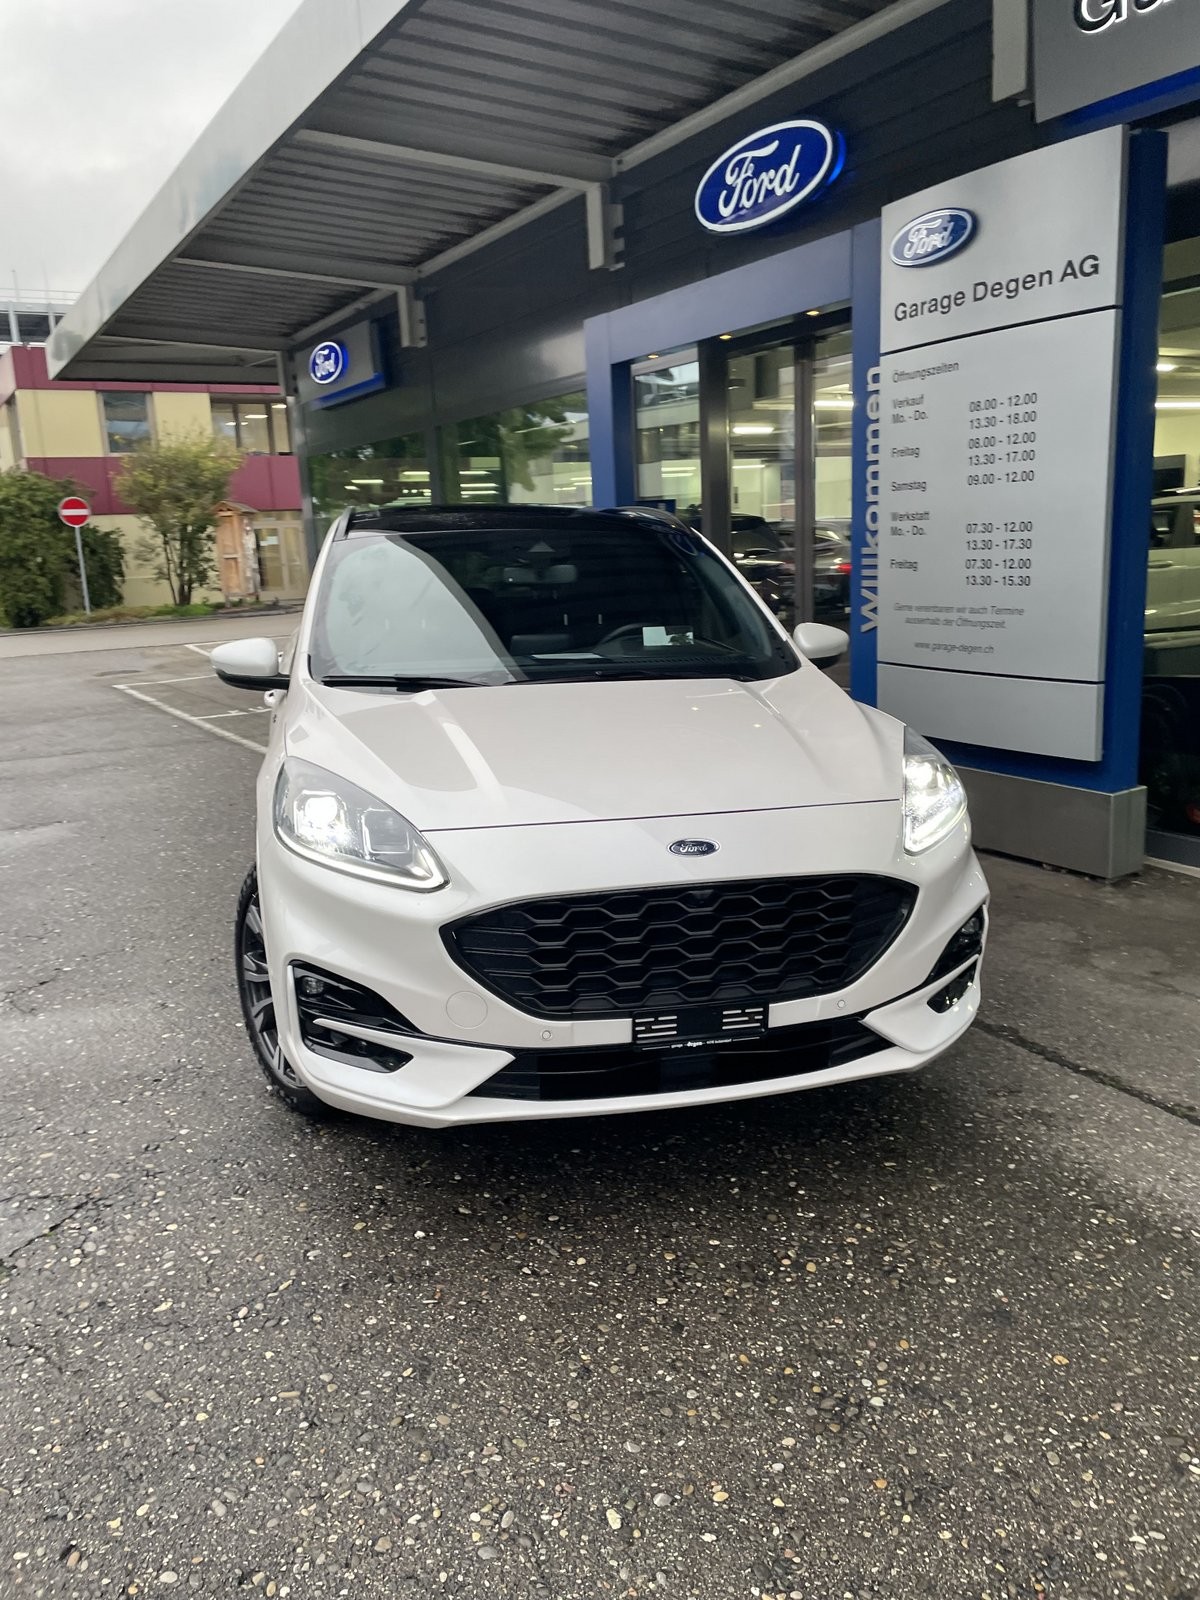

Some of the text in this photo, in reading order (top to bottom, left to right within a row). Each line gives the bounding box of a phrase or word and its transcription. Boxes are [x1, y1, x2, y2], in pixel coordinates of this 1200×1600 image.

[718, 140, 801, 217] Ford
[903, 218, 955, 259] Ford
[894, 254, 1100, 321] Garage Degen AG
[315, 348, 336, 378] Ford
[892, 362, 960, 384] Öffnungszeiten
[892, 394, 924, 409] Verkauf
[969, 398, 997, 412] 08.00
[1008, 392, 1038, 407] 12.00
[914, 410, 928, 421] Do.
[969, 415, 996, 430] 13.30
[1006, 410, 1037, 424] 18.00
[968, 435, 996, 449] 08.00
[1006, 431, 1036, 445] 12.00
[891, 447, 920, 458] Freitag
[968, 453, 996, 466] 13.30
[1005, 449, 1036, 463] 17.00
[967, 473, 995, 486] 09.00
[1005, 470, 1035, 483] 12.00
[891, 481, 927, 492] Samstag
[860, 366, 881, 634] Willkommen
[890, 511, 930, 522] Werkstatt
[911, 525, 927, 536] Do.
[966, 522, 993, 534] 07.30
[1003, 521, 1033, 533] 12.00
[965, 539, 993, 551] 13.30
[1002, 538, 1032, 550] 17.30
[890, 559, 918, 572] Freitag
[965, 558, 992, 570] 07.30
[1002, 558, 1031, 569] 12.00
[965, 575, 992, 586] 13.30
[1002, 575, 1031, 587] 15.30
[680, 842, 708, 853] Ford
